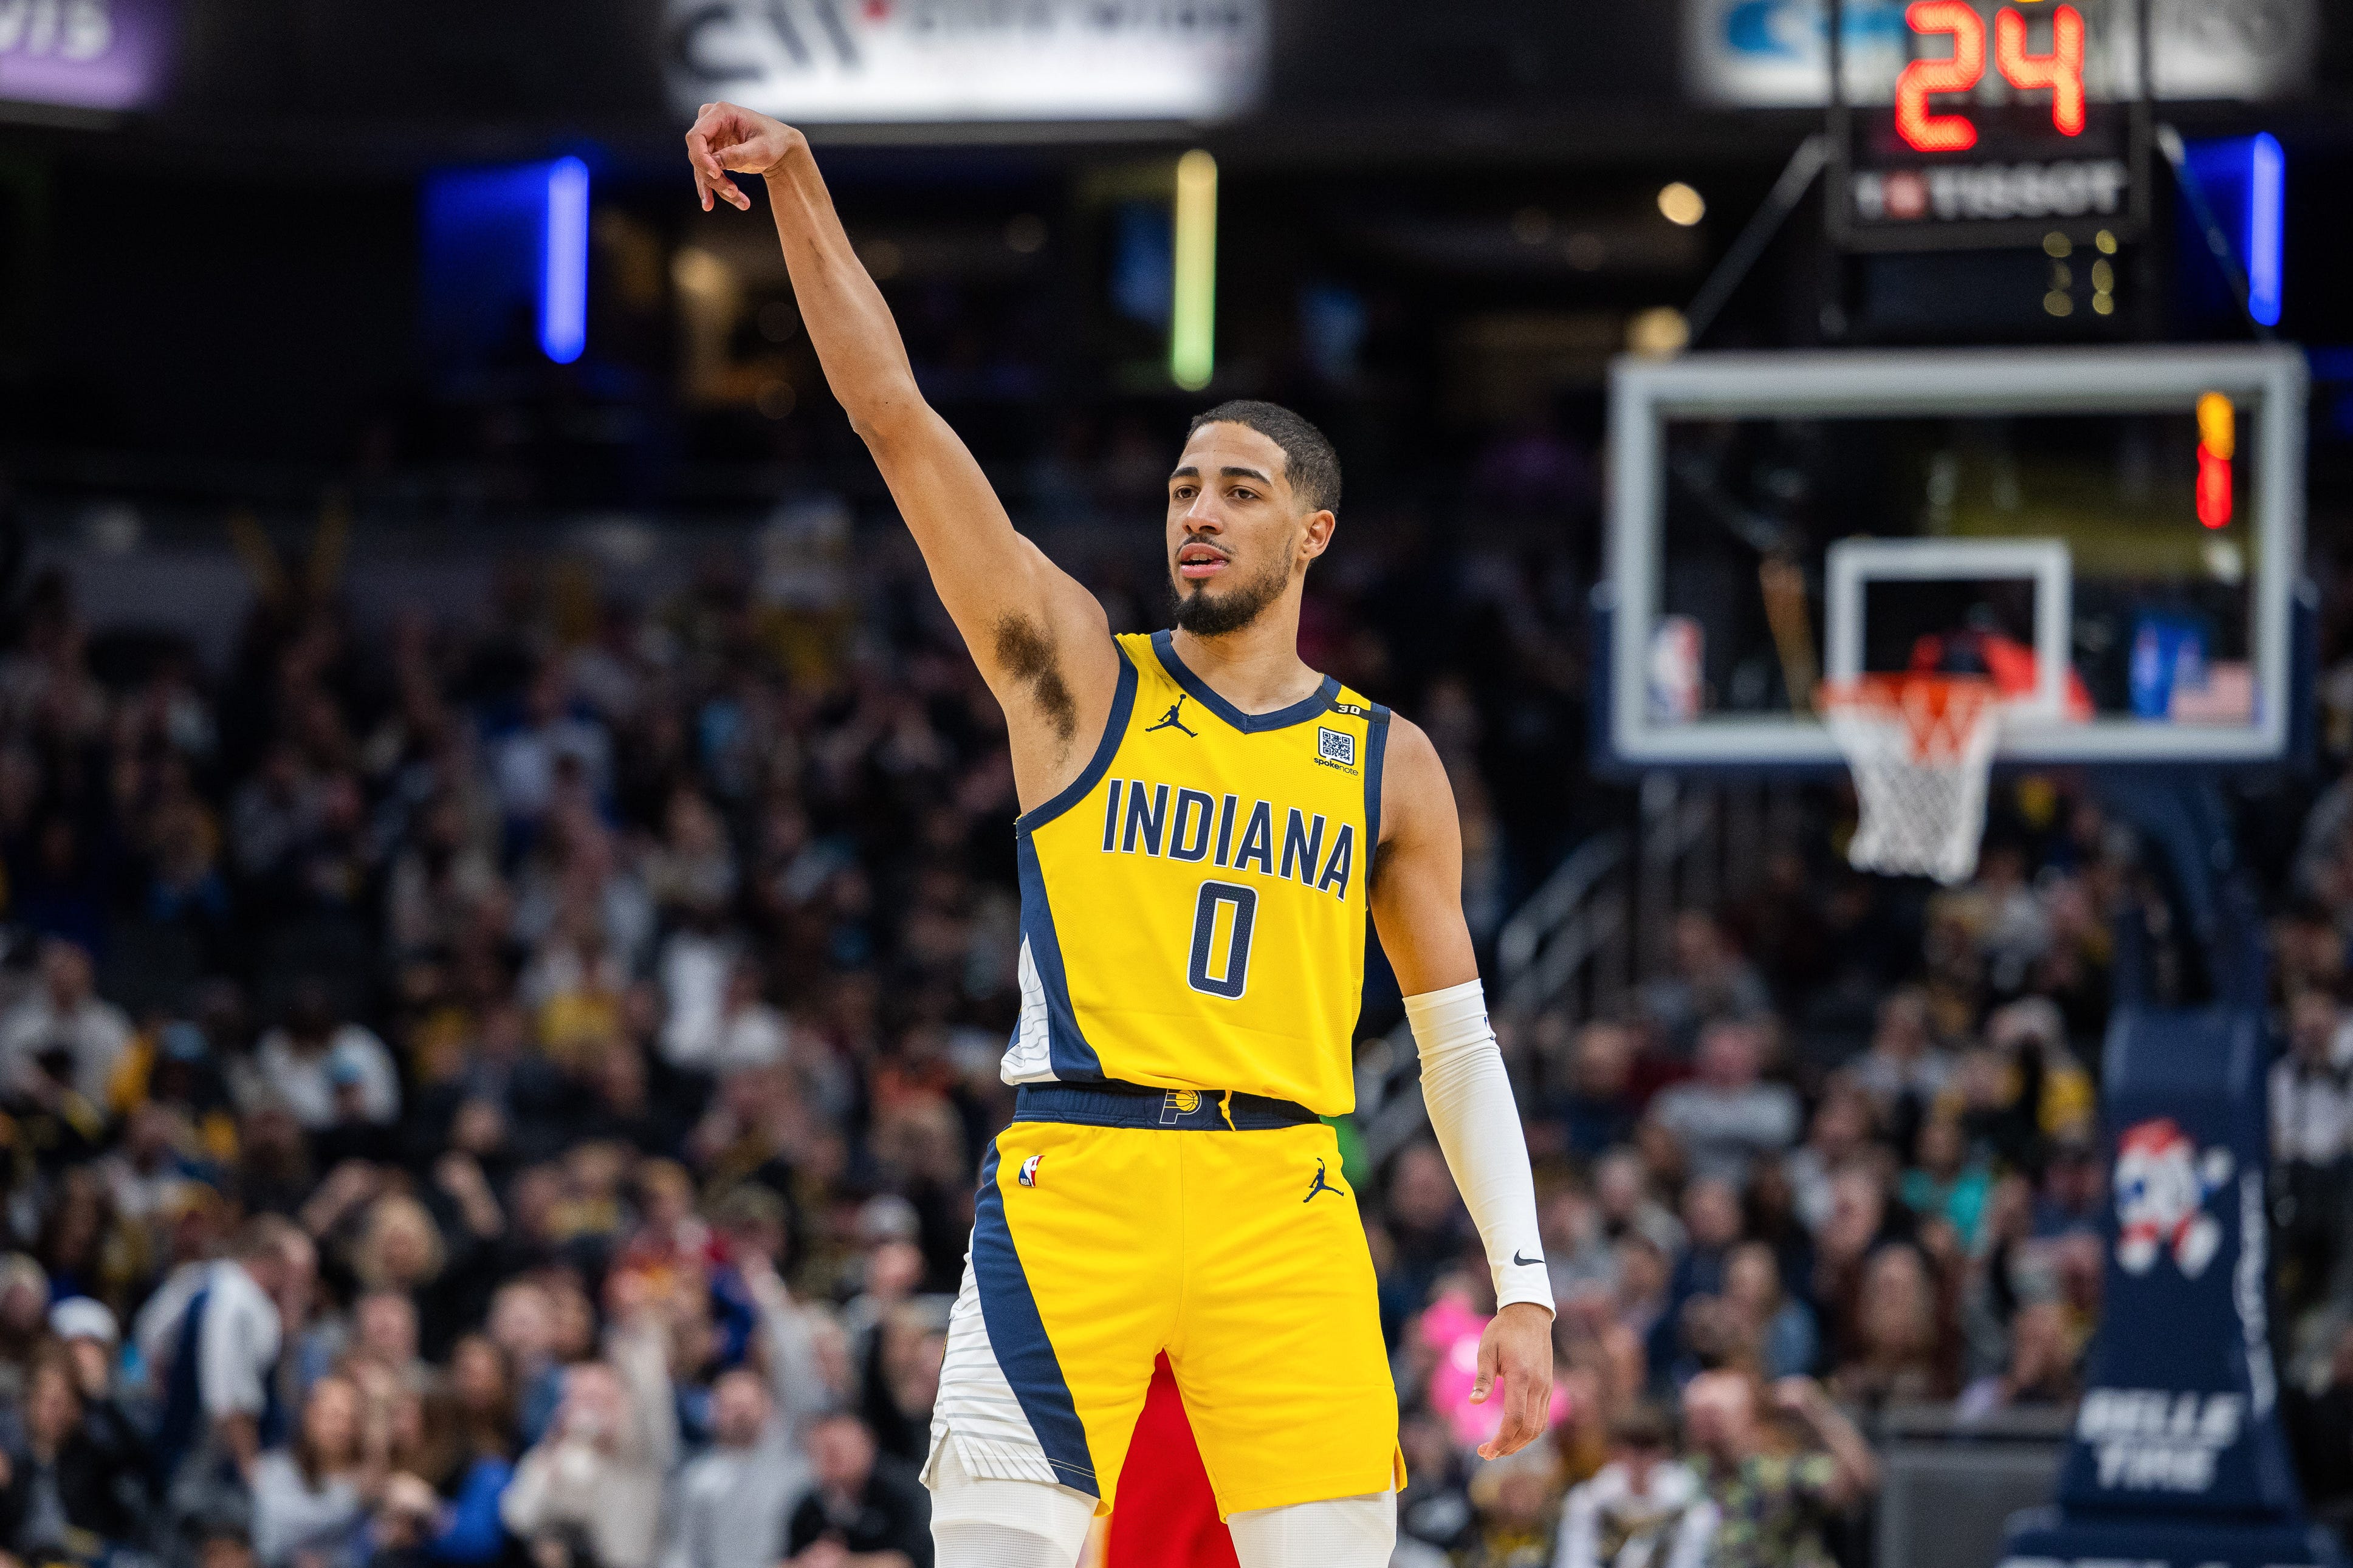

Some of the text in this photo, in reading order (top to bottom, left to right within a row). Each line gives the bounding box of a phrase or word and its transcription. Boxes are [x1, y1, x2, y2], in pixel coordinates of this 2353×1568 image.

[1895, 0, 2085, 152] 24
[1930, 160, 2128, 220] TISSOT
[1338, 705, 1361, 715] 30
[1314, 757, 1359, 776] spokenote
[1101, 778, 1356, 903] INDIANA
[1186, 878, 1259, 1001] 0
[1020, 1177, 1030, 1186] NBA
